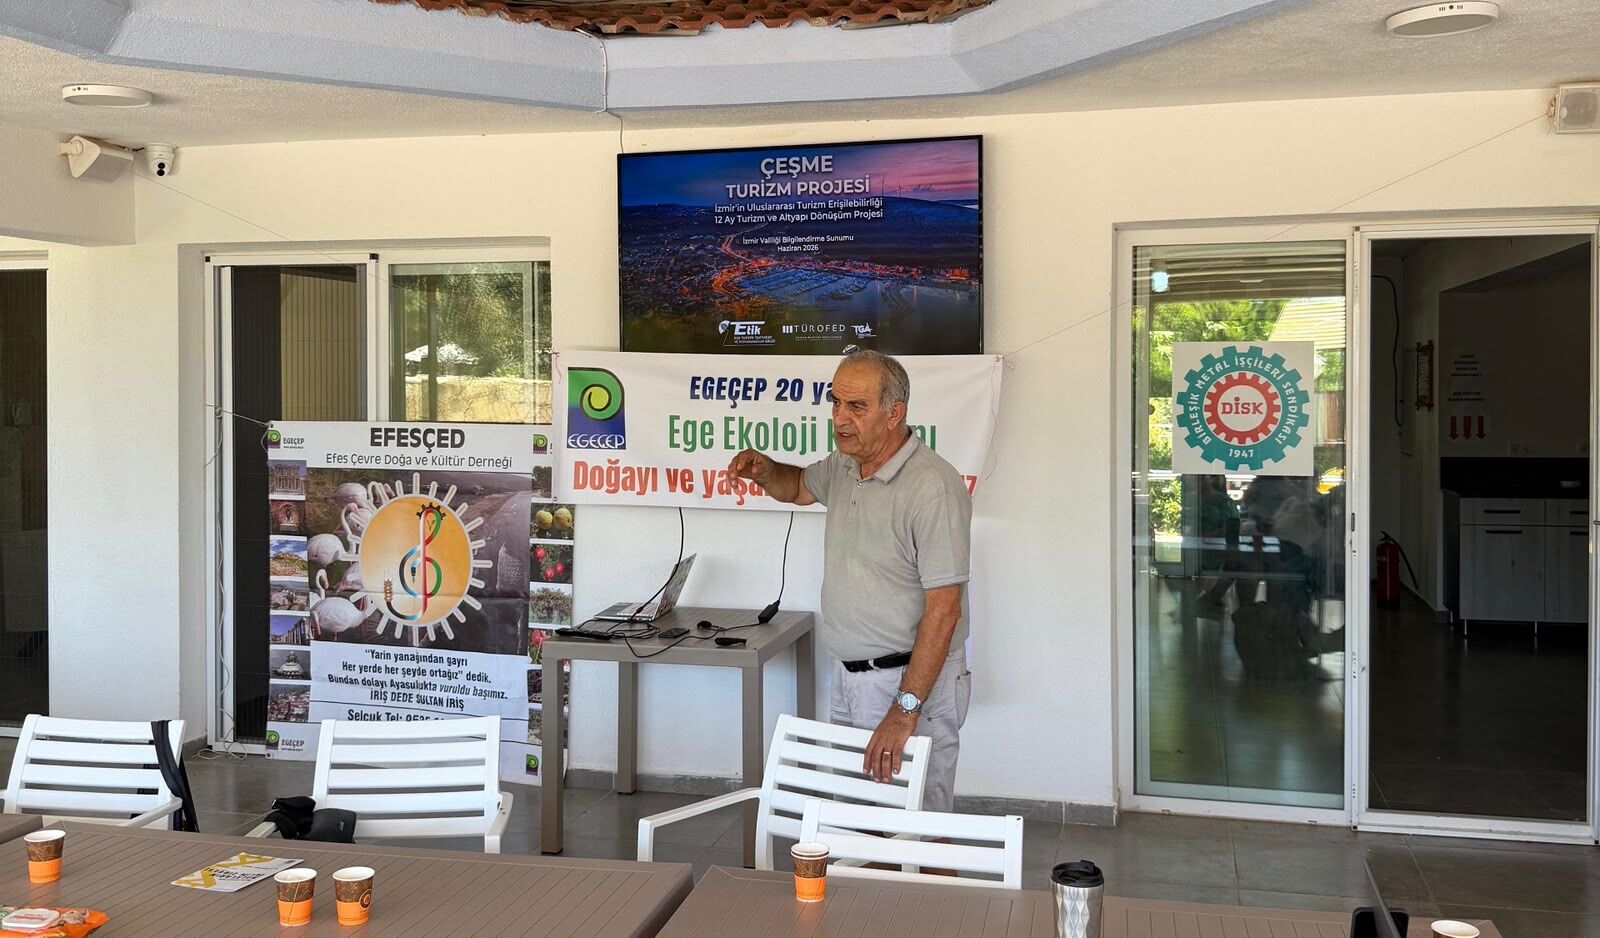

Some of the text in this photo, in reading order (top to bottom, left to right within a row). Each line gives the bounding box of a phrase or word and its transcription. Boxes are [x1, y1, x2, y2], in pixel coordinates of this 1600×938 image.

[760, 155, 834, 179] ÇEŞME
[726, 175, 870, 198] TURİZM PROJESİ
[714, 198, 883, 213] İzmir'in Uluslararası Turizm Erişilebilirliği
[714, 209, 883, 226] 12 Ay Turizm ve Altyapı Dönüşüm Projesi
[742, 236, 759, 245] İzmir
[782, 236, 826, 244] Bilgilendirme
[826, 234, 854, 242] Sunumu
[731, 321, 765, 336] Etik
[794, 324, 846, 334] TÜROFED
[690, 376, 768, 409] EGEÇEP
[775, 378, 804, 402] 20
[1188, 355, 1299, 446] BİRLEŞİK METAL İŞÇİLERİ SENDİKASI
[1221, 396, 1264, 415] DİSK
[283, 438, 304, 446] EGEÇEP
[370, 428, 466, 453] EFESÇED
[668, 414, 714, 454] Ege
[724, 416, 817, 456] Ekoloji
[326, 453, 512, 469] Efes Çevre Doğa ve Kültür Derneği
[1228, 448, 1254, 458] 1947
[573, 458, 658, 496] Doğayı
[666, 468, 694, 493] ve
[342, 661, 356, 672] Her
[358, 663, 382, 674] yerde
[384, 663, 399, 674] her
[401, 665, 427, 678] şeyde
[466, 671, 492, 684] dedik.
[446, 656, 468, 668] gayrı
[328, 674, 508, 700] Bundan dolayı Ayasulukta vuruldu başımız.
[370, 688, 465, 711] İRİŞ DEDE SULTAN İRİŞ
